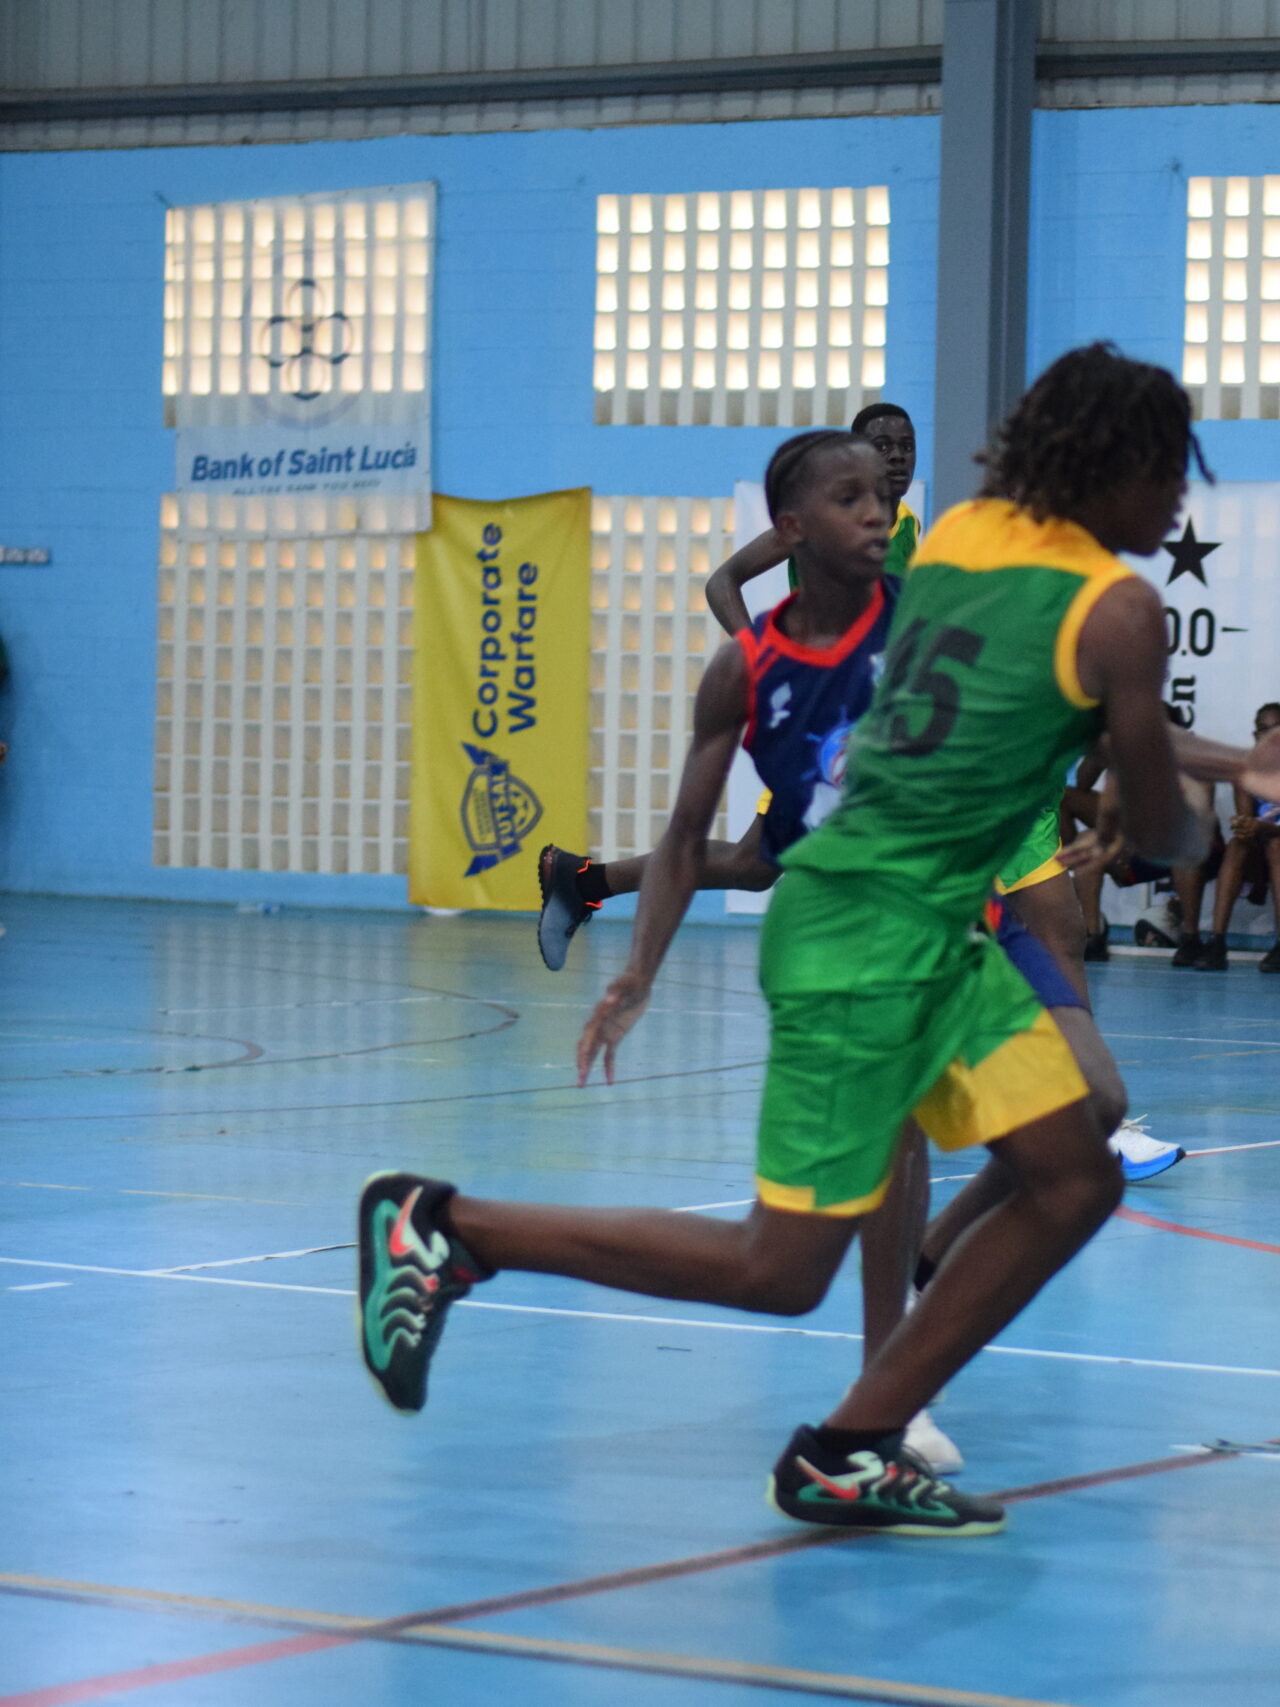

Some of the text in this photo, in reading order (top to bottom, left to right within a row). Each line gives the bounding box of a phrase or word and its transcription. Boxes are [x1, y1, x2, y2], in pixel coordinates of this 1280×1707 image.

[191, 441, 417, 482] Bank of Saint Lucia
[472, 523, 507, 739] Corporate
[507, 562, 539, 734] Warfare
